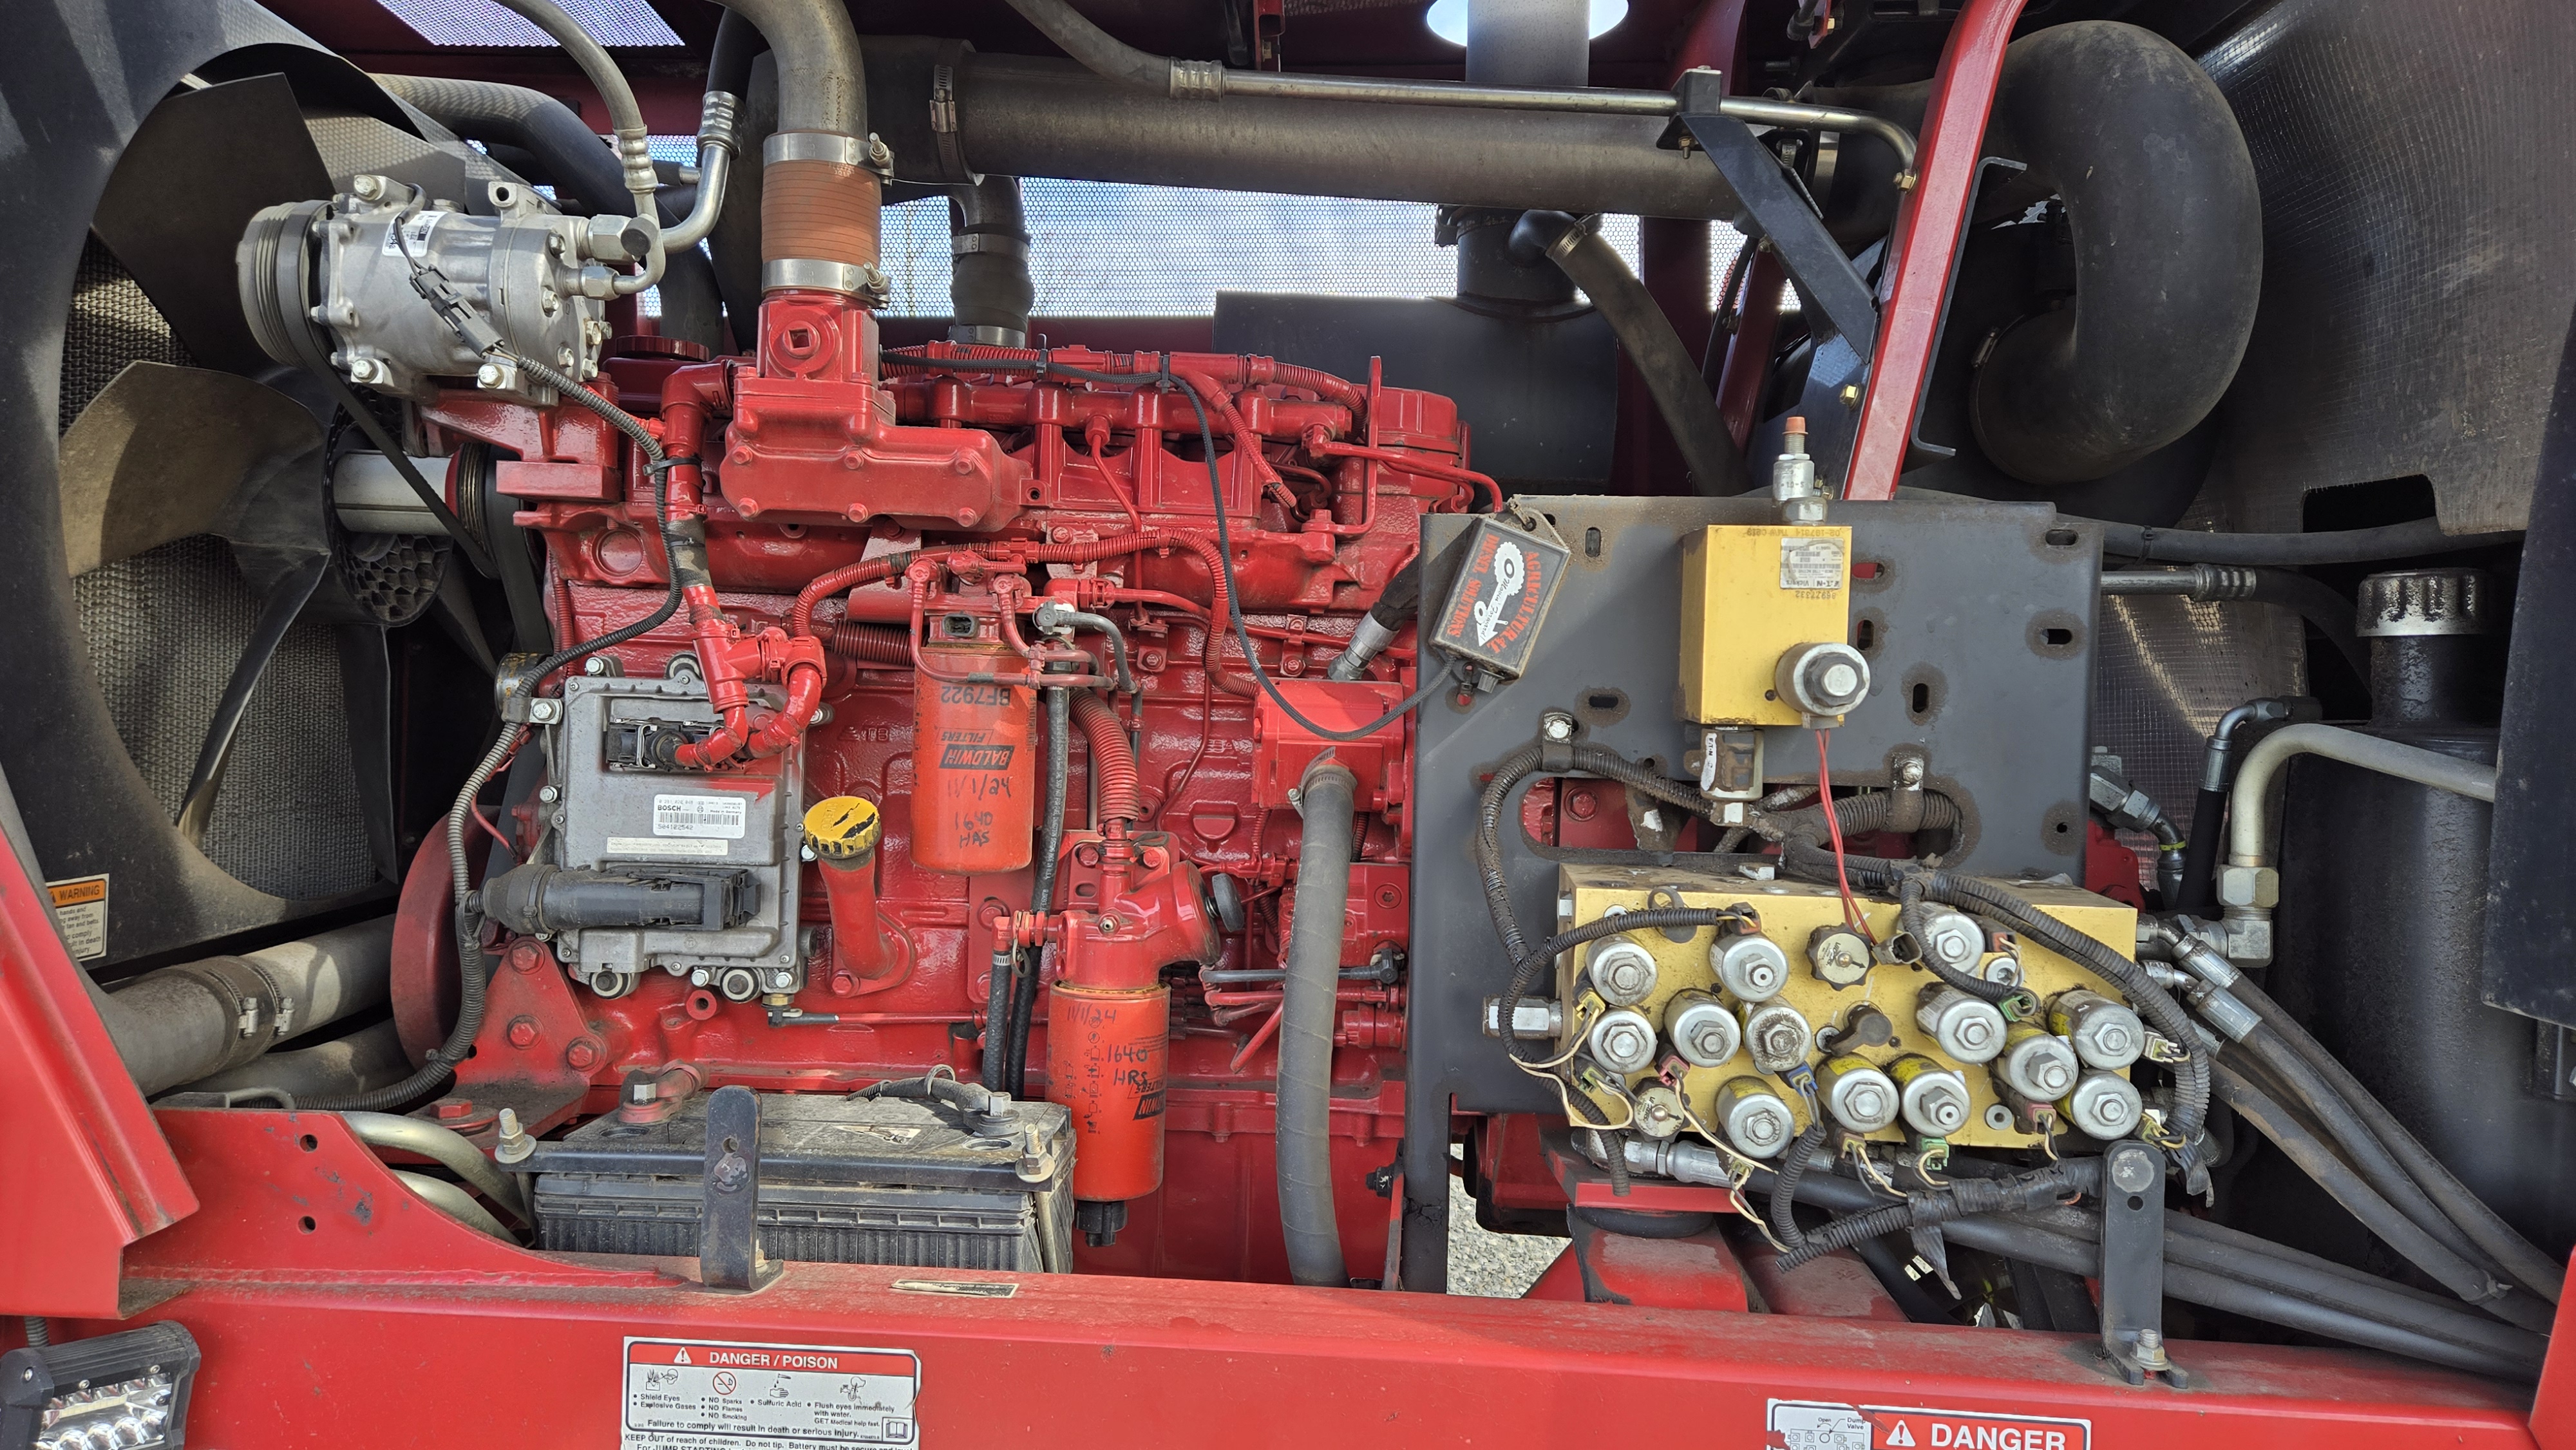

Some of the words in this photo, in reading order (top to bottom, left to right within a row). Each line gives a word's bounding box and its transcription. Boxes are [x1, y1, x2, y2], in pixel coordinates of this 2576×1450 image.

[1473, 533, 1500, 574] DIESEL
[1446, 578, 1482, 638] SOLUTIONS
[1486, 551, 1542, 654] AGRICULTURAL
[940, 686, 1011, 706] BF7922
[940, 731, 987, 744] FILTERS
[943, 748, 1010, 766] BALDWIN
[955, 811, 993, 831] 1640
[59, 885, 100, 900] WARNING
[71, 930, 93, 939] comply
[86, 936, 102, 945] death
[1106, 1044, 1149, 1064] 1640
[1113, 1069, 1149, 1086] HRS
[1139, 1098, 1163, 1114] DWIN
[709, 1351, 771, 1366] DANGER
[782, 1355, 838, 1370] POISON
[853, 1404, 895, 1413] immediately
[647, 1420, 674, 1428] Failure
[687, 1422, 715, 1431] comply
[734, 1424, 756, 1432] result
[758, 1424, 765, 1433] in
[768, 1426, 790, 1434] death
[802, 1427, 832, 1436] serious
[834, 1428, 860, 1438] injury.
[1931, 1422, 2067, 1450] DANGER
[648, 1434, 665, 1442] OUT
[667, 1435, 674, 1443] of
[676, 1436, 697, 1444] reach
[709, 1436, 741, 1446] children.
[746, 1439, 757, 1447] Do
[773, 1441, 784, 1449] tip.
[789, 1442, 816, 1450] Battery
